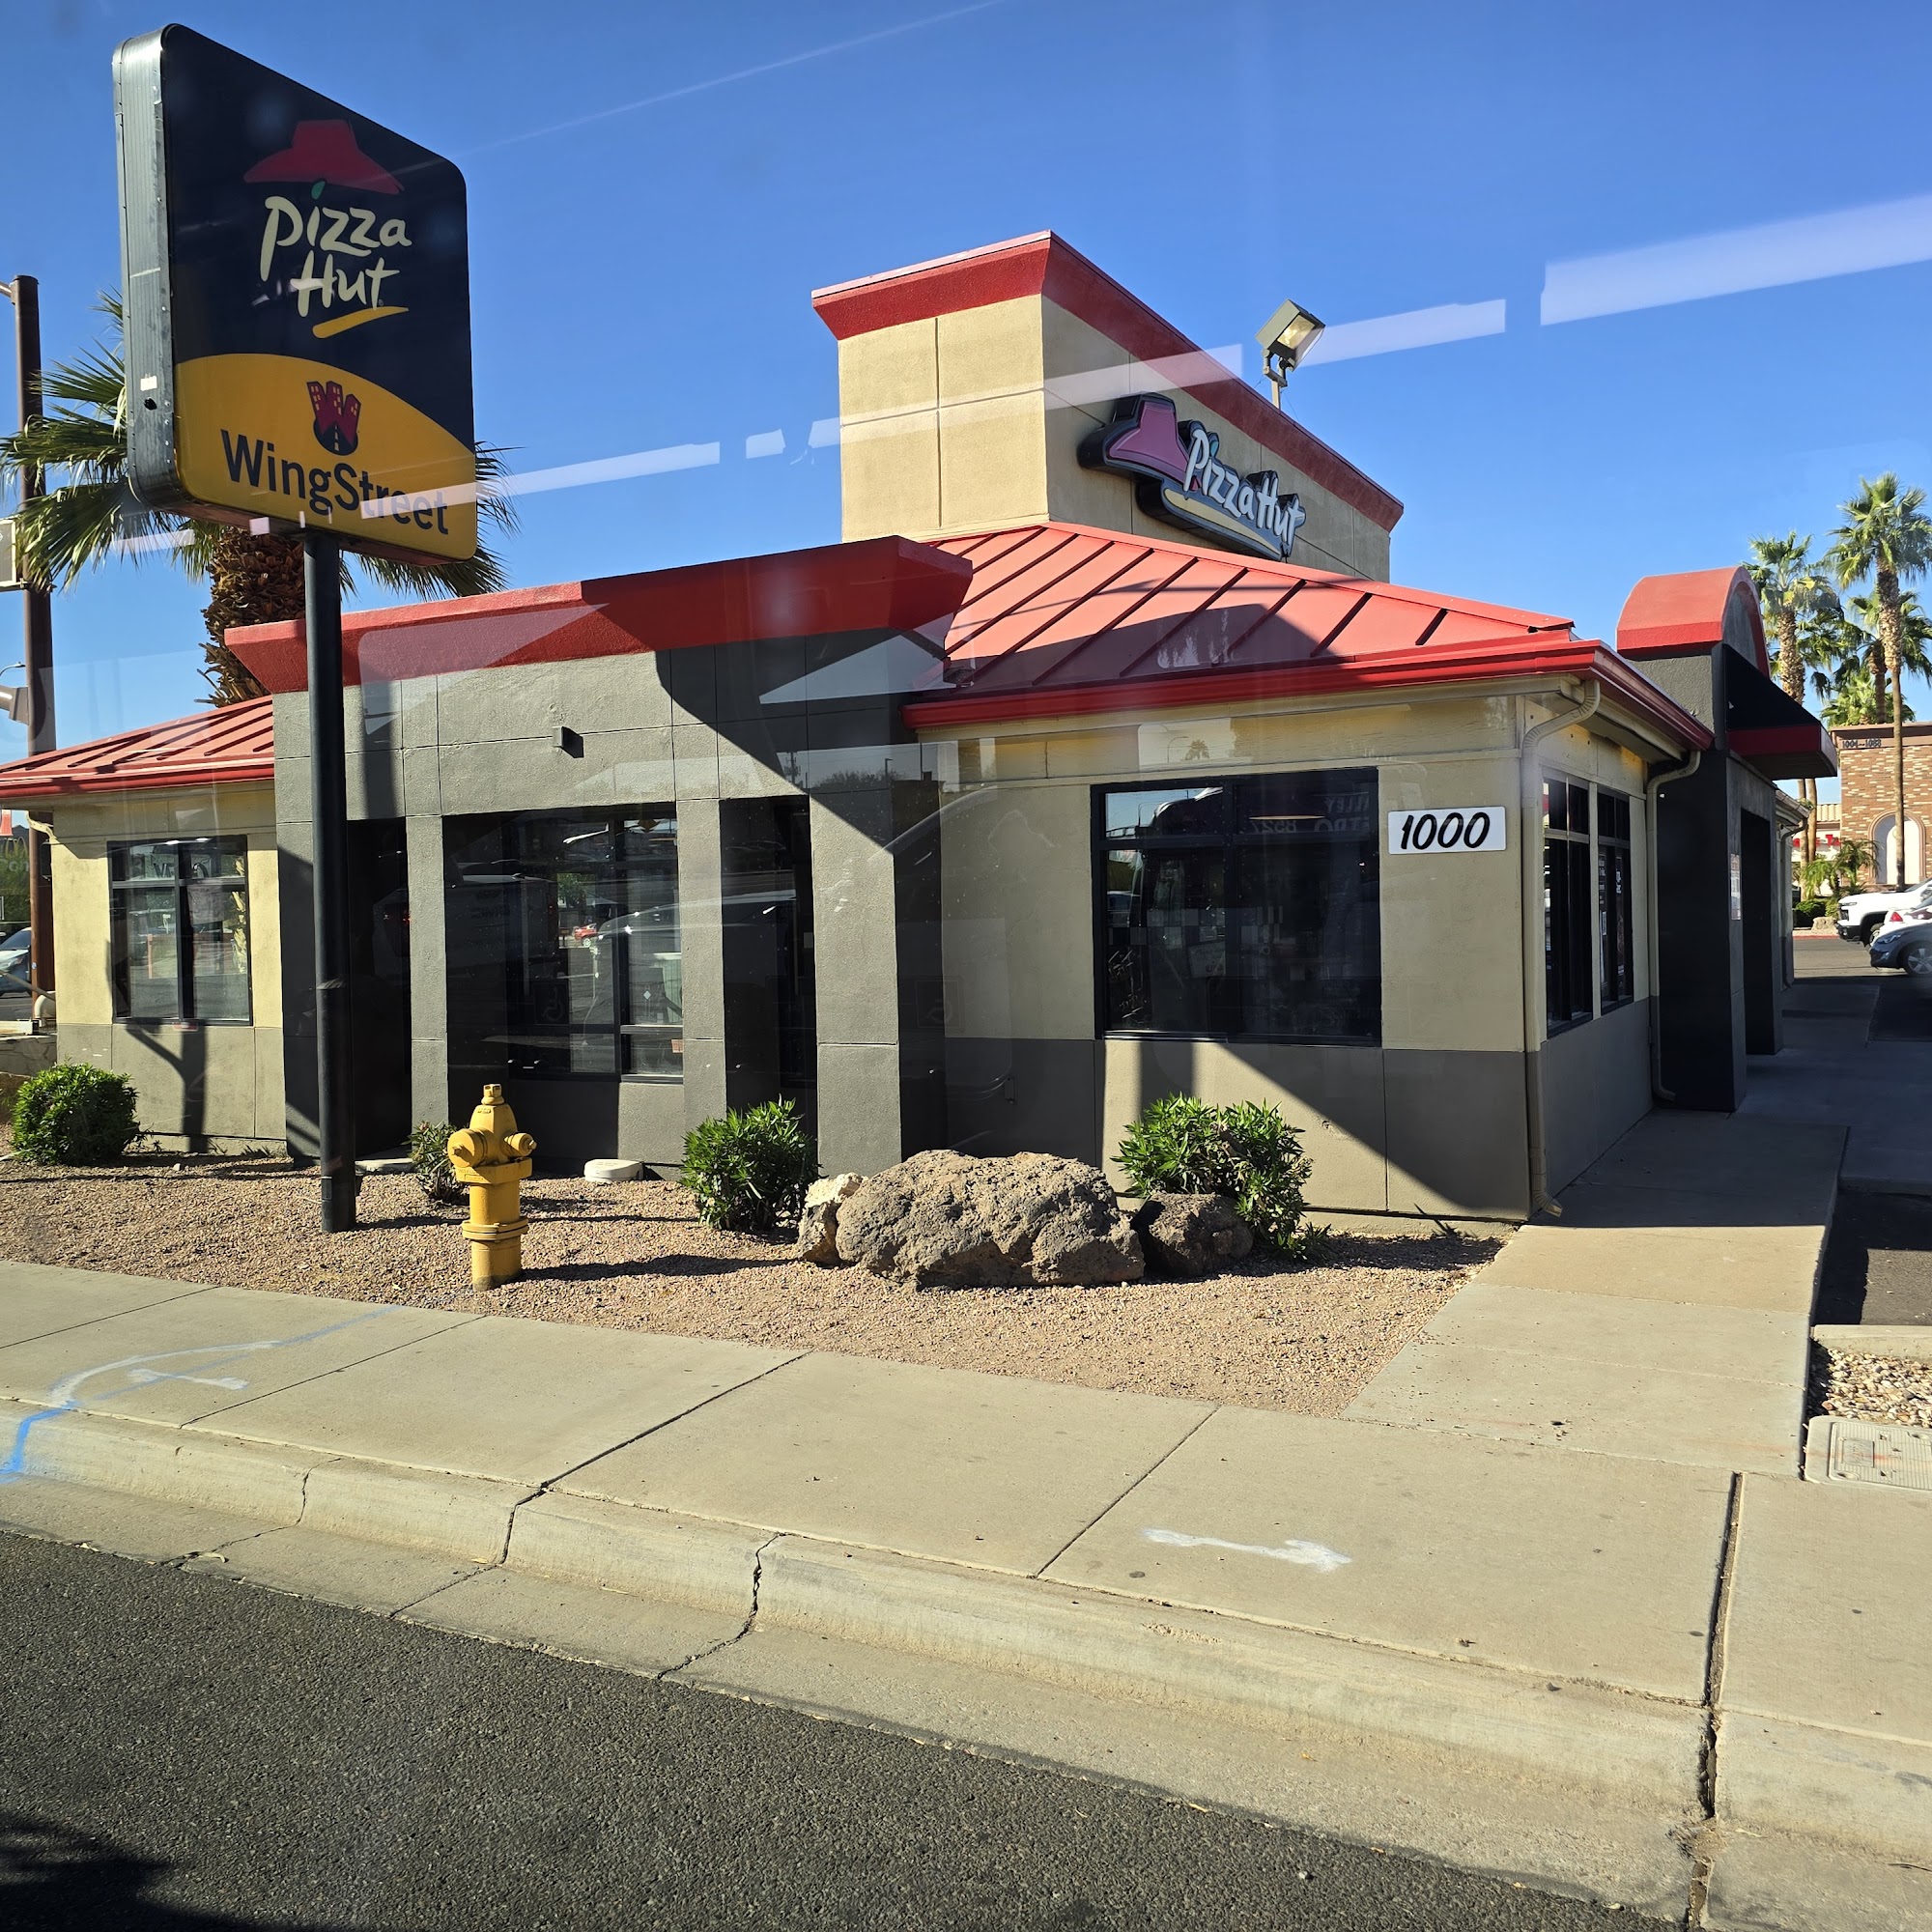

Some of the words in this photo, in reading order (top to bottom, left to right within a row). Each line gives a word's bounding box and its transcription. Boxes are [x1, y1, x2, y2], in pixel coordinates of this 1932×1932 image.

[259, 182, 412, 282] Pizza
[290, 250, 400, 318] Hut
[220, 428, 449, 535] WingStreet
[1183, 429, 1255, 521] Pizza
[1256, 472, 1307, 548] Hut
[1401, 811, 1491, 850] 1000
